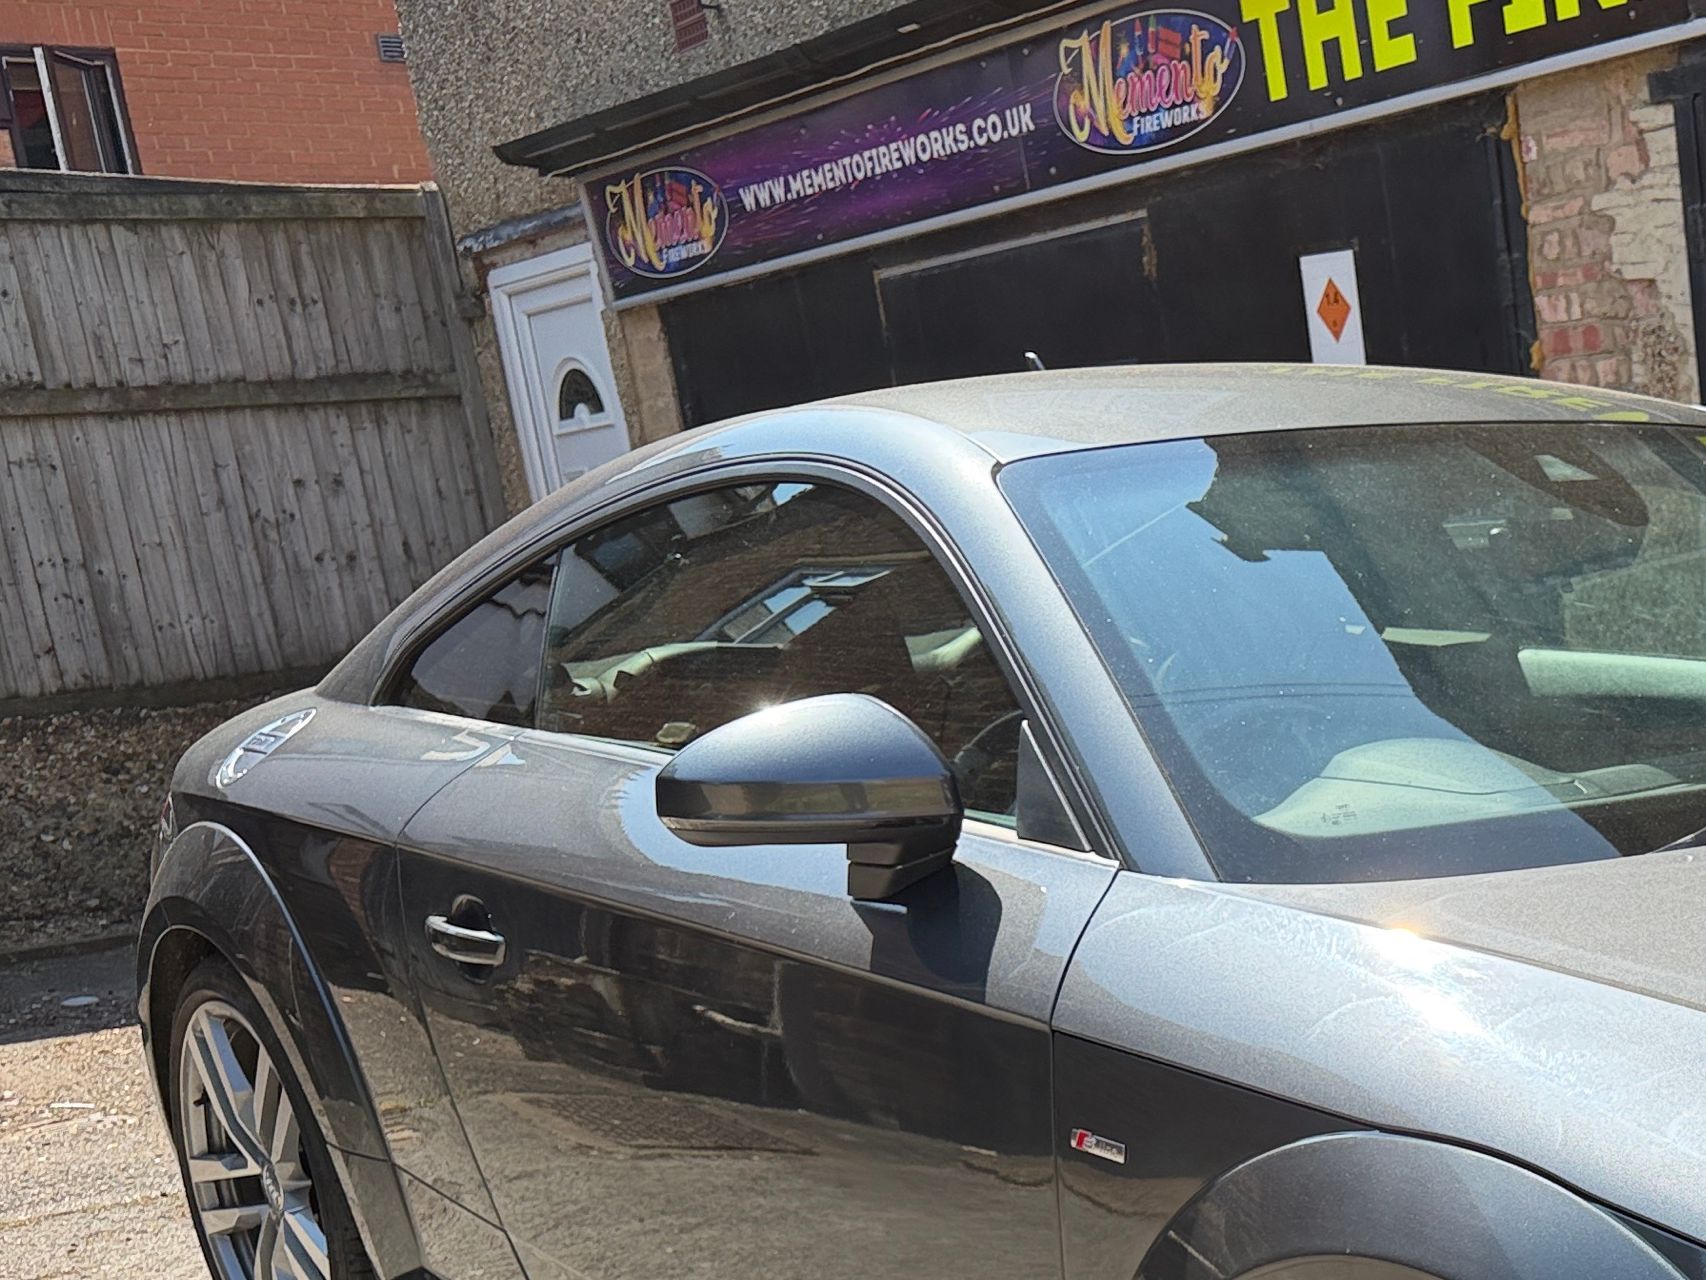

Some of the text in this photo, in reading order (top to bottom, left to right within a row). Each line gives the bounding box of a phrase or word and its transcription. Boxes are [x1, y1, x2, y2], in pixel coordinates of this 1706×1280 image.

[1059, 20, 1231, 145] Memento
[1240, 0, 1417, 101] THE
[738, 103, 1035, 212] WWW.MEMENTOFIREWORKS.CO.UK
[1132, 101, 1206, 135] FIREWORKS
